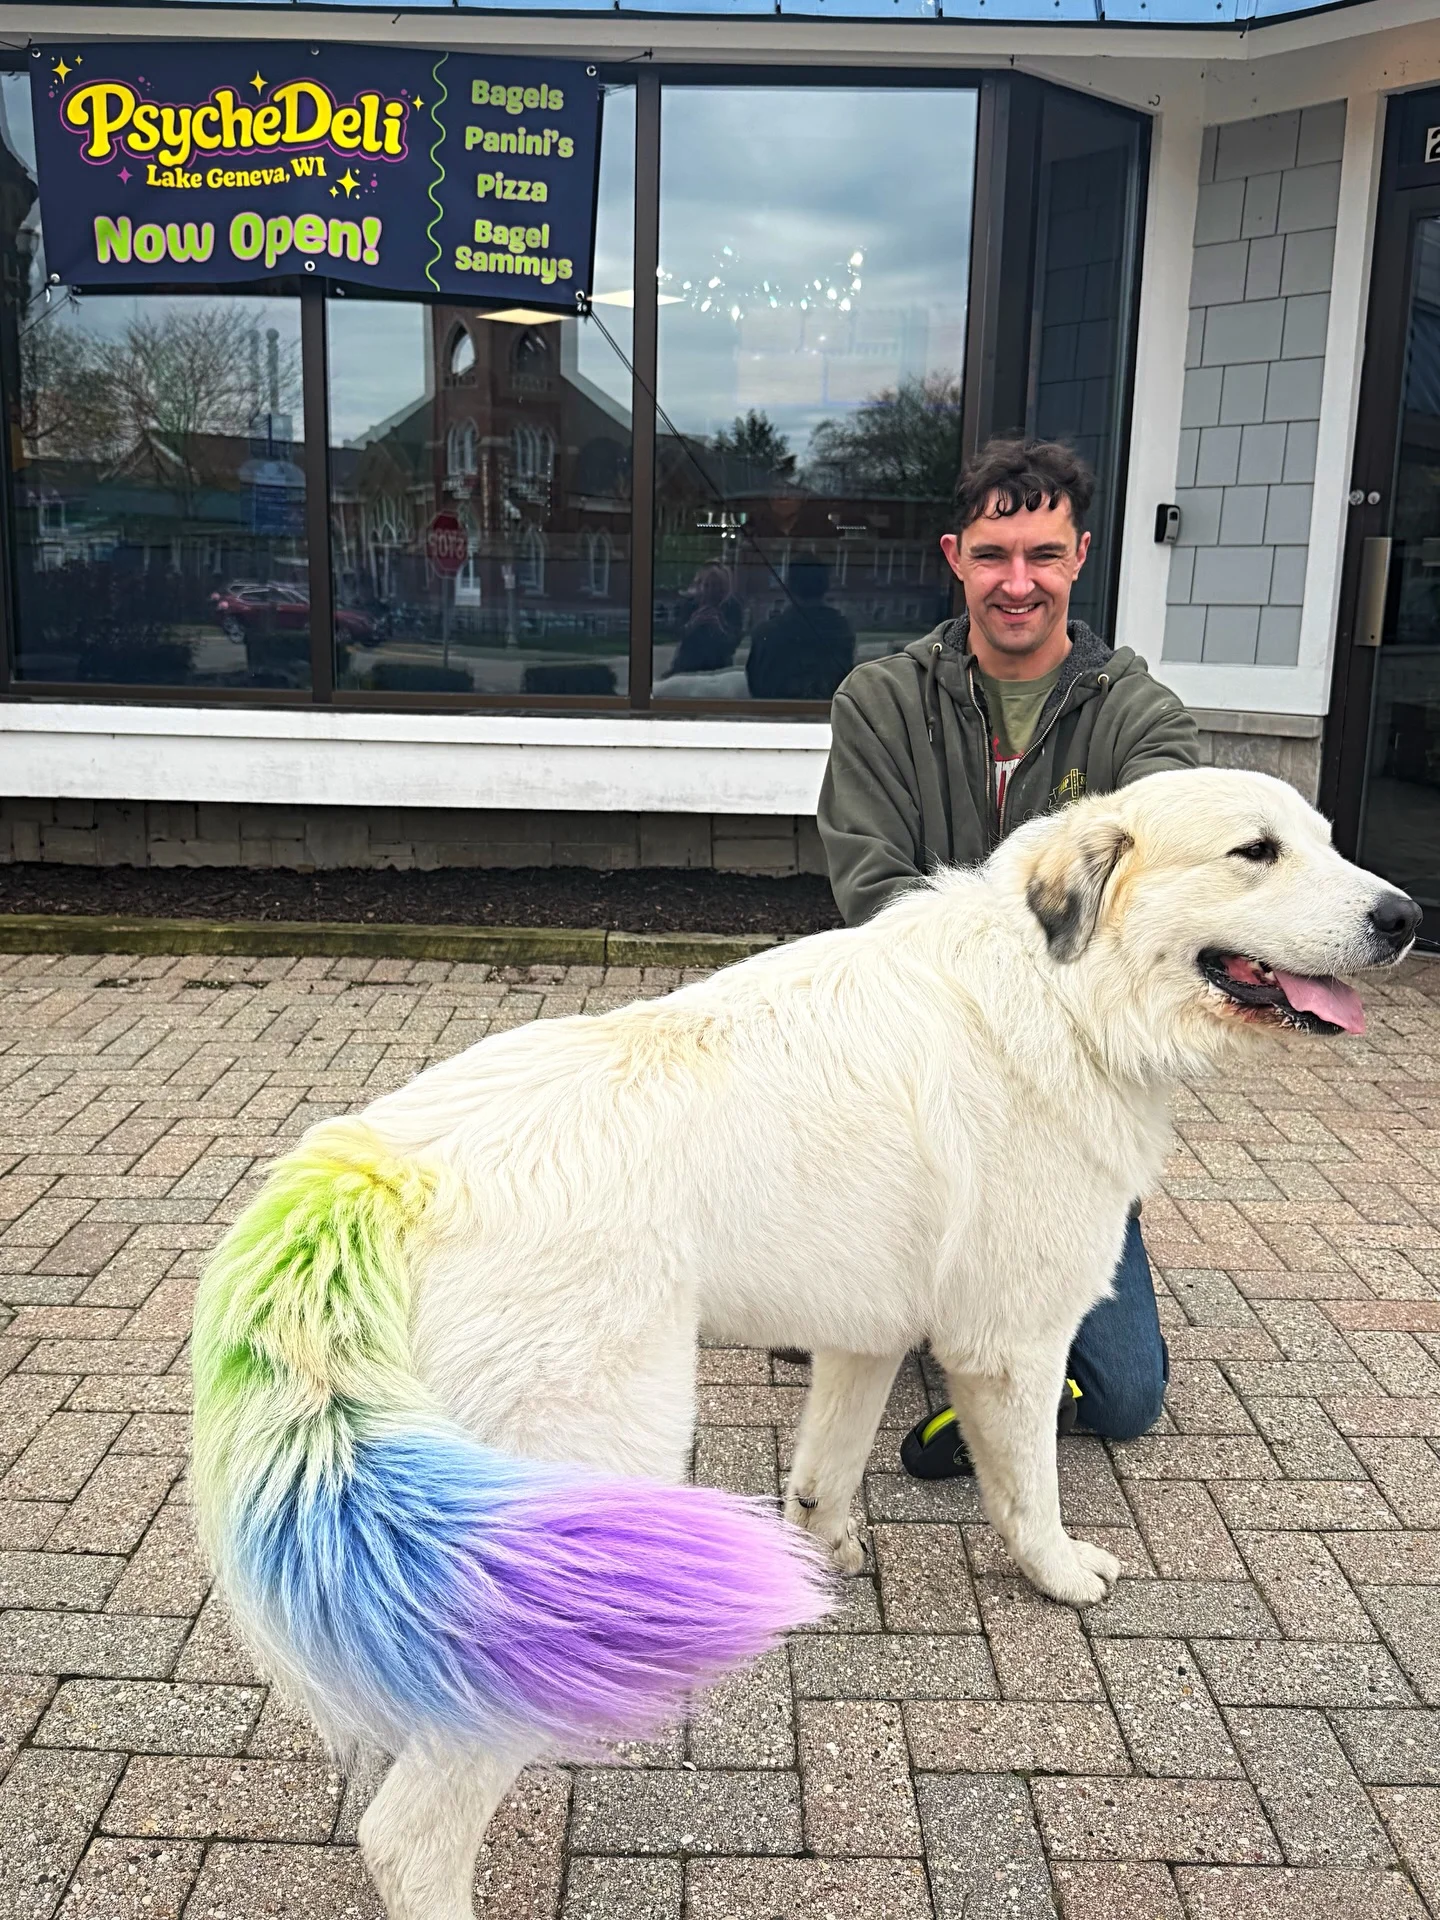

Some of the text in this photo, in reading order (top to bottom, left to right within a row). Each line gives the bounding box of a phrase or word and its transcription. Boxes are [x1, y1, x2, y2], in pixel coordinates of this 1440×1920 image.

[471, 79, 564, 115] Bagels
[66, 81, 404, 167] PsycheDeli
[465, 126, 574, 158] Panini's
[146, 156, 327, 188] Lake Geneva, WI
[477, 171, 548, 202] Pizza
[94, 212, 382, 268] Now Open!
[474, 219, 550, 253] Bagel
[455, 246, 573, 284] Sammys
